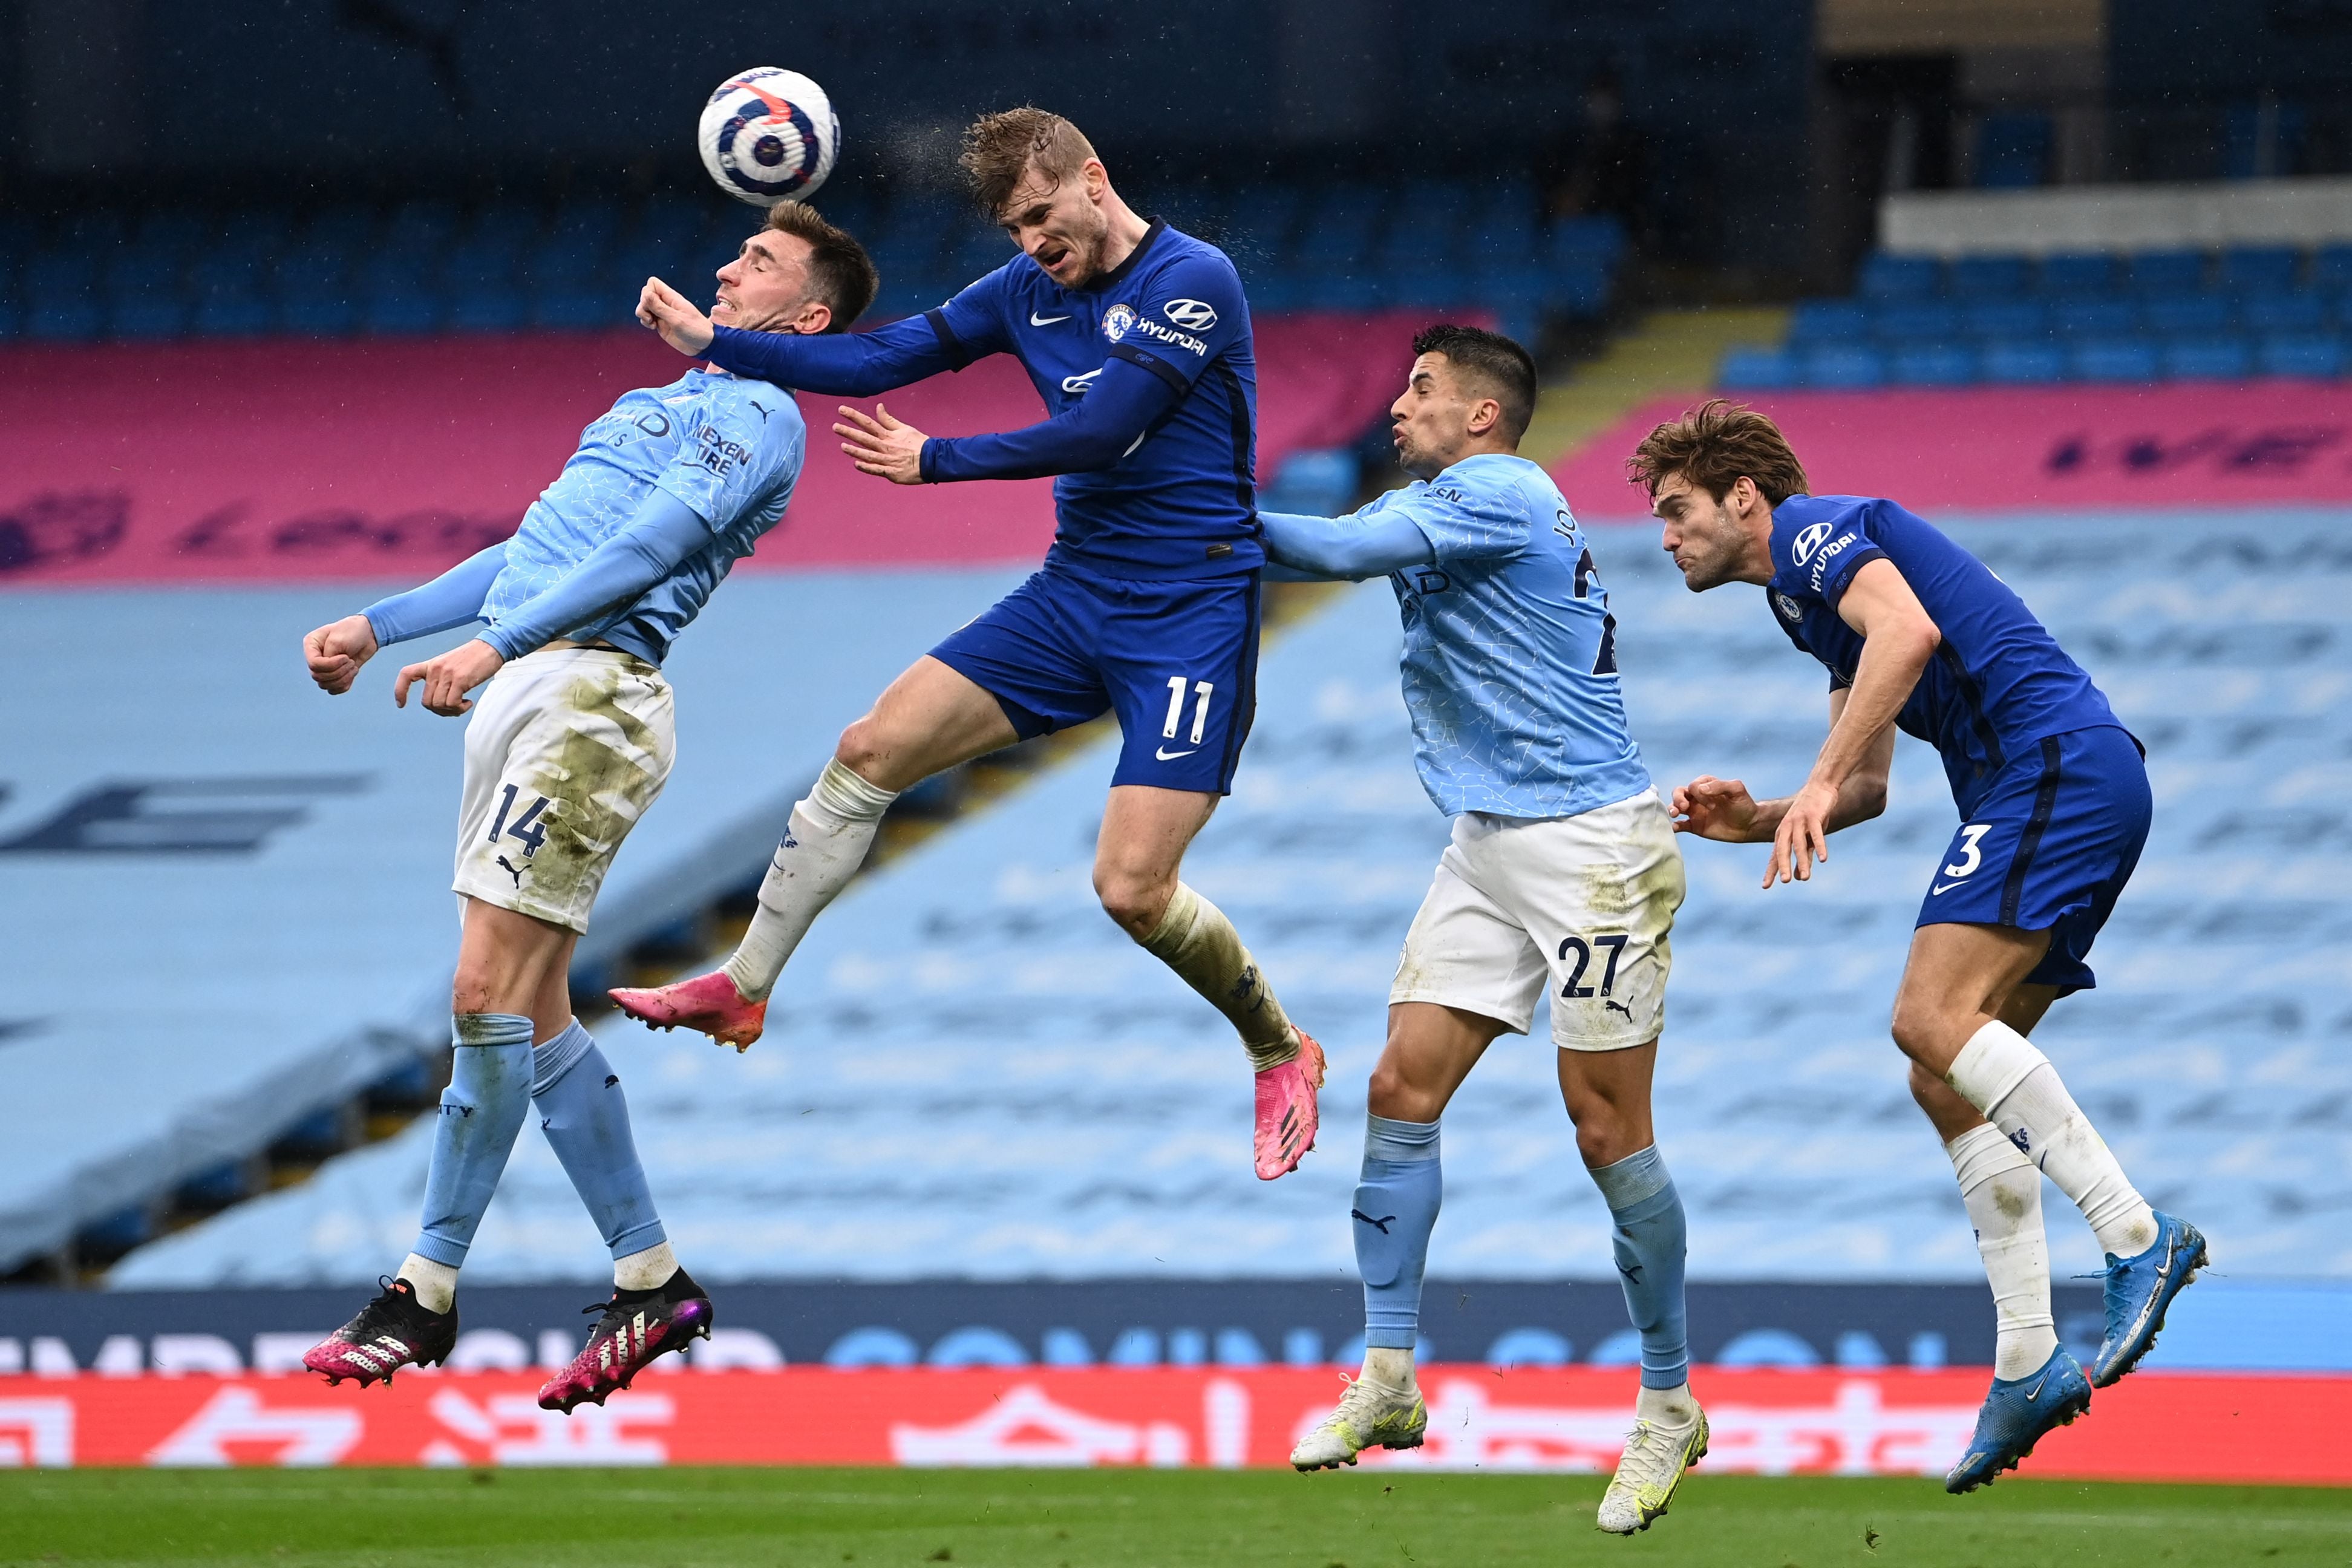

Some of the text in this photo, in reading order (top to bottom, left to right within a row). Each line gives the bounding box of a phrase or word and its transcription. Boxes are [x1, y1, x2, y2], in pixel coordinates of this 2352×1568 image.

[1106, 305, 1129, 318] CHELSEA
[1137, 317, 1207, 357] HYUNDAI
[692, 424, 753, 466] NEXEN
[696, 443, 733, 475] TIRE
[1810, 532, 1857, 592] HYUNDAI
[1162, 676, 1214, 745] 11
[487, 783, 551, 860] 14
[1944, 824, 1993, 877] 3
[1558, 933, 1630, 998] 27
